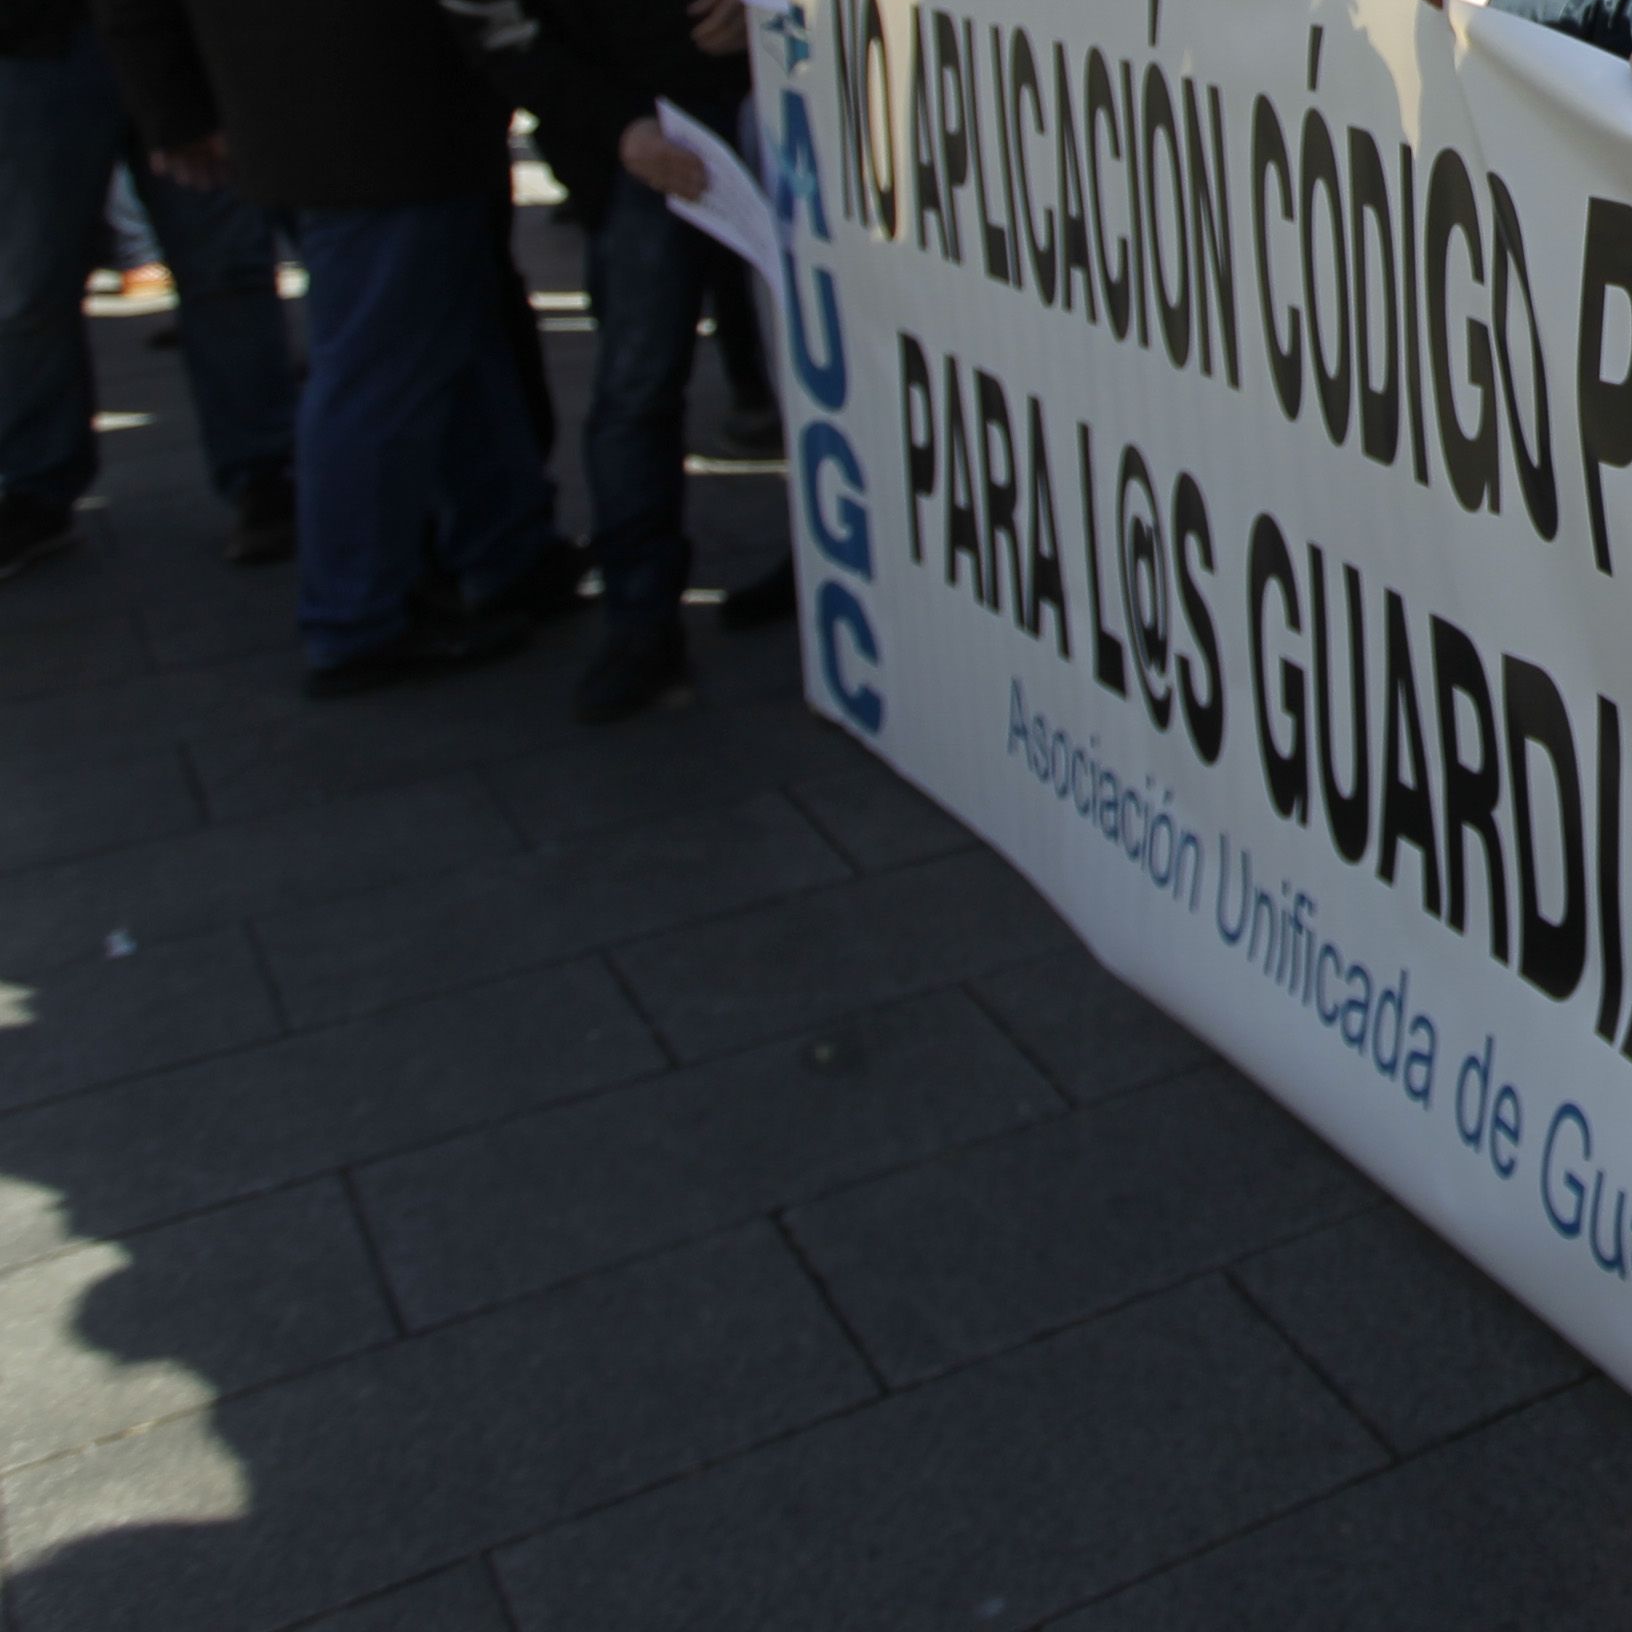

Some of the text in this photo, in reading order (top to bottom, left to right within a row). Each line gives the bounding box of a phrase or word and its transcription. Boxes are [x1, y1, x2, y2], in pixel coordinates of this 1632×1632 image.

[1251, 24, 1560, 543] CÓDIGO
[898, 332, 1073, 662] PARA
[1076, 422, 1224, 765] L@S
[1008, 678, 1200, 912] Asociación
[1214, 832, 1436, 1110] Unificada
[1455, 1035, 1522, 1180] de
